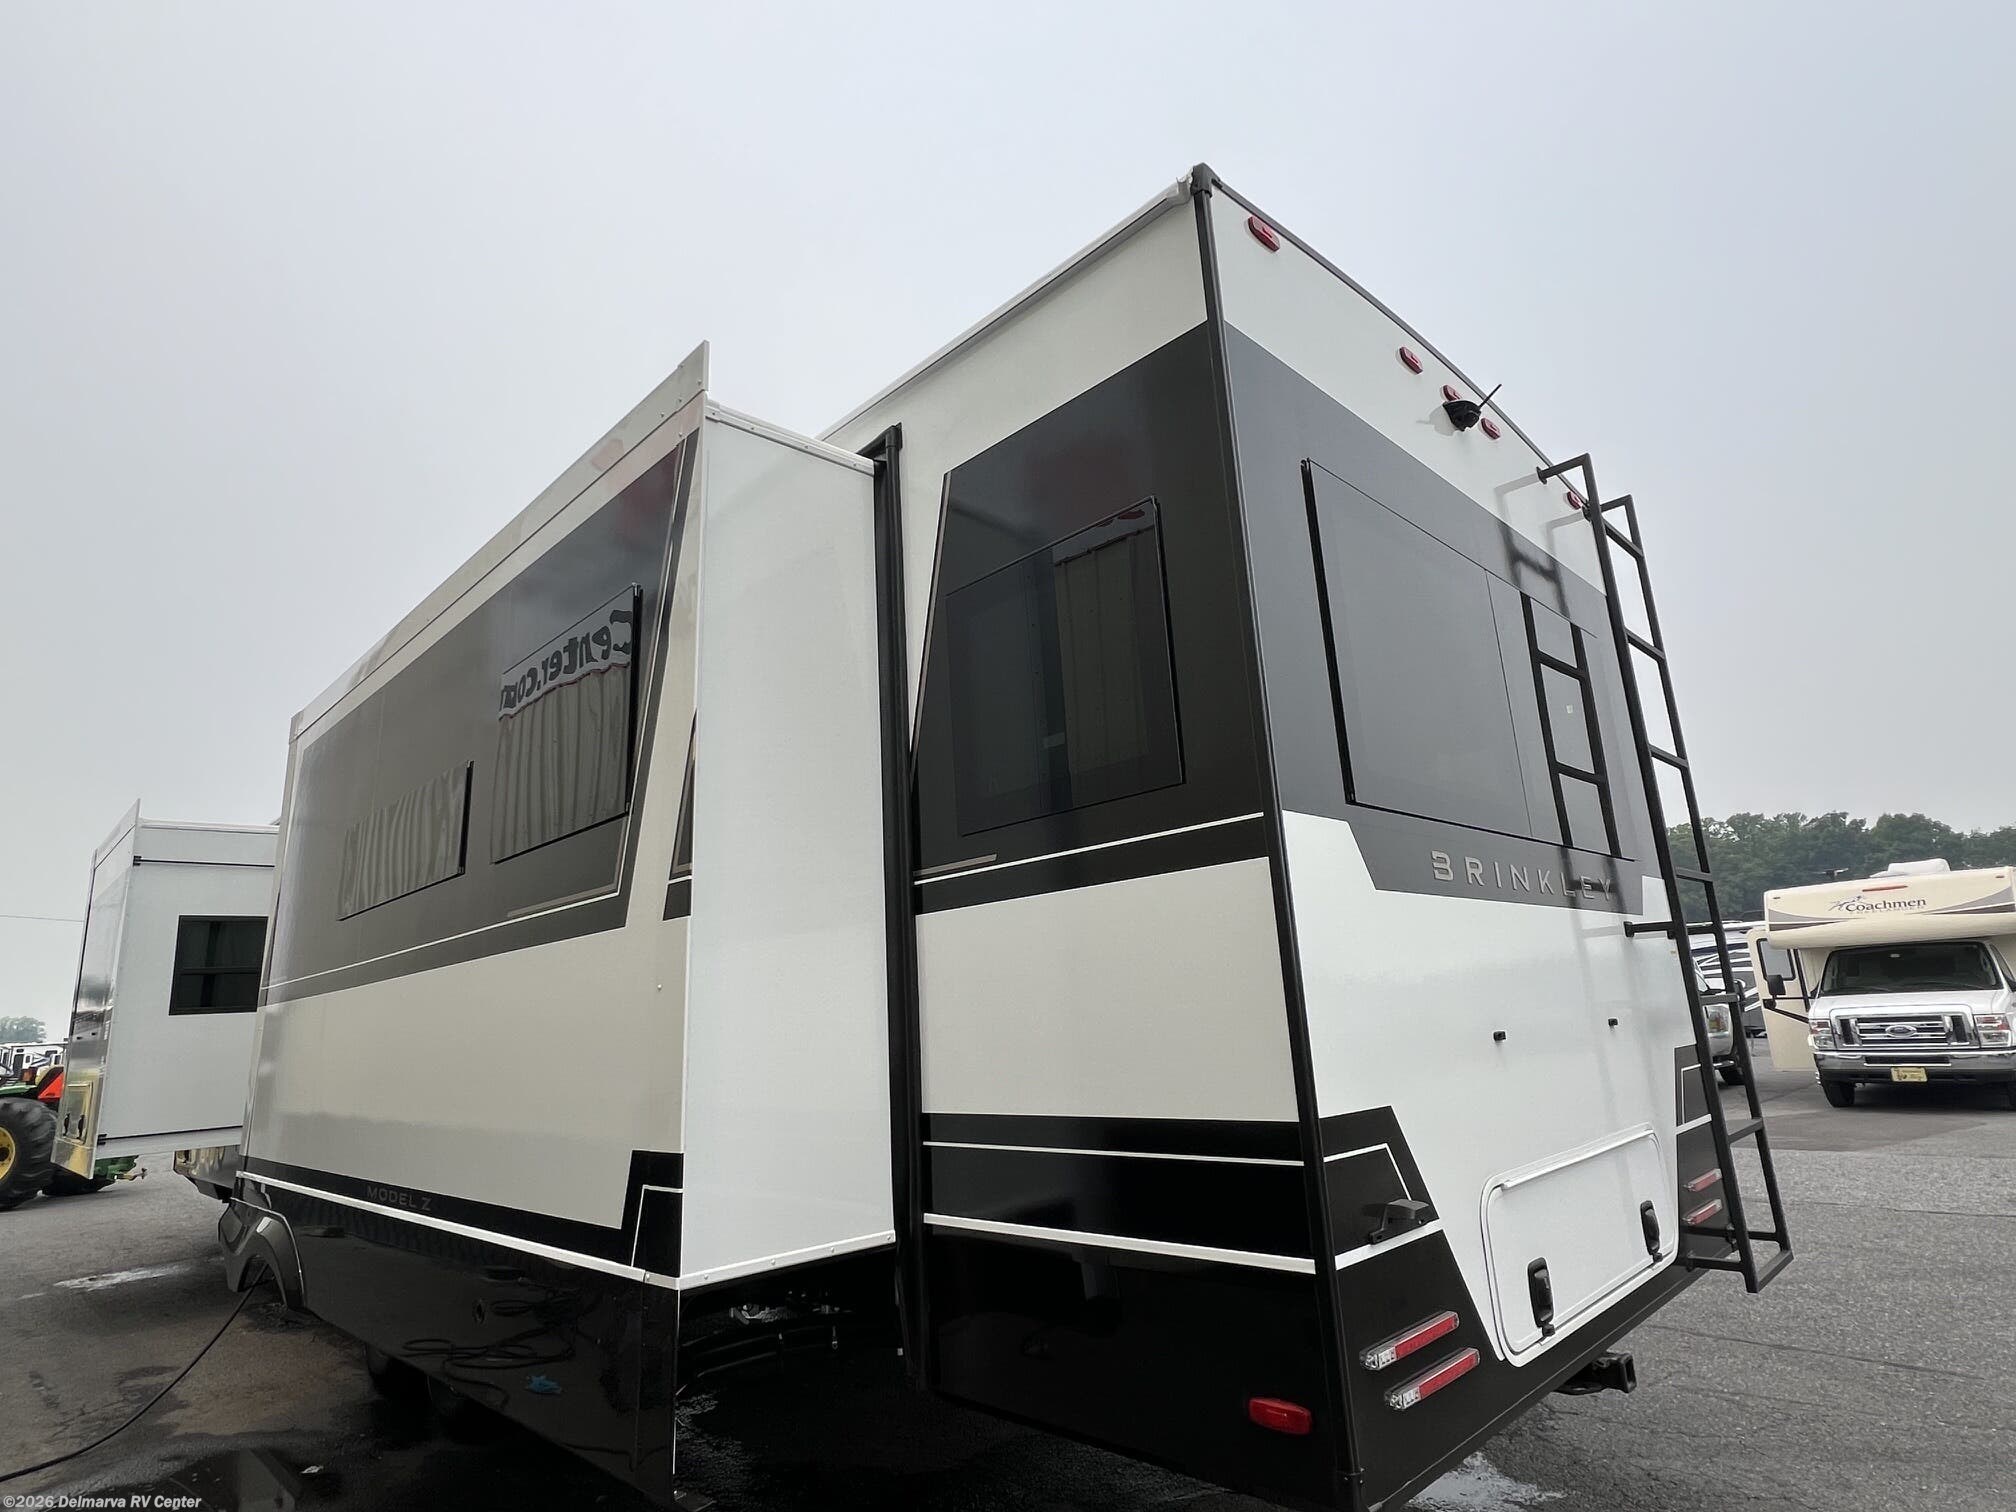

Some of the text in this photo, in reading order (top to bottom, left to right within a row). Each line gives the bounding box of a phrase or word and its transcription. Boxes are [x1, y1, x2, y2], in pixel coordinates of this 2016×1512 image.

[1431, 850, 1614, 901] BRINKLEY
[1845, 898, 1927, 912] Coachmen
[366, 1185, 432, 1211] MODEL Z
